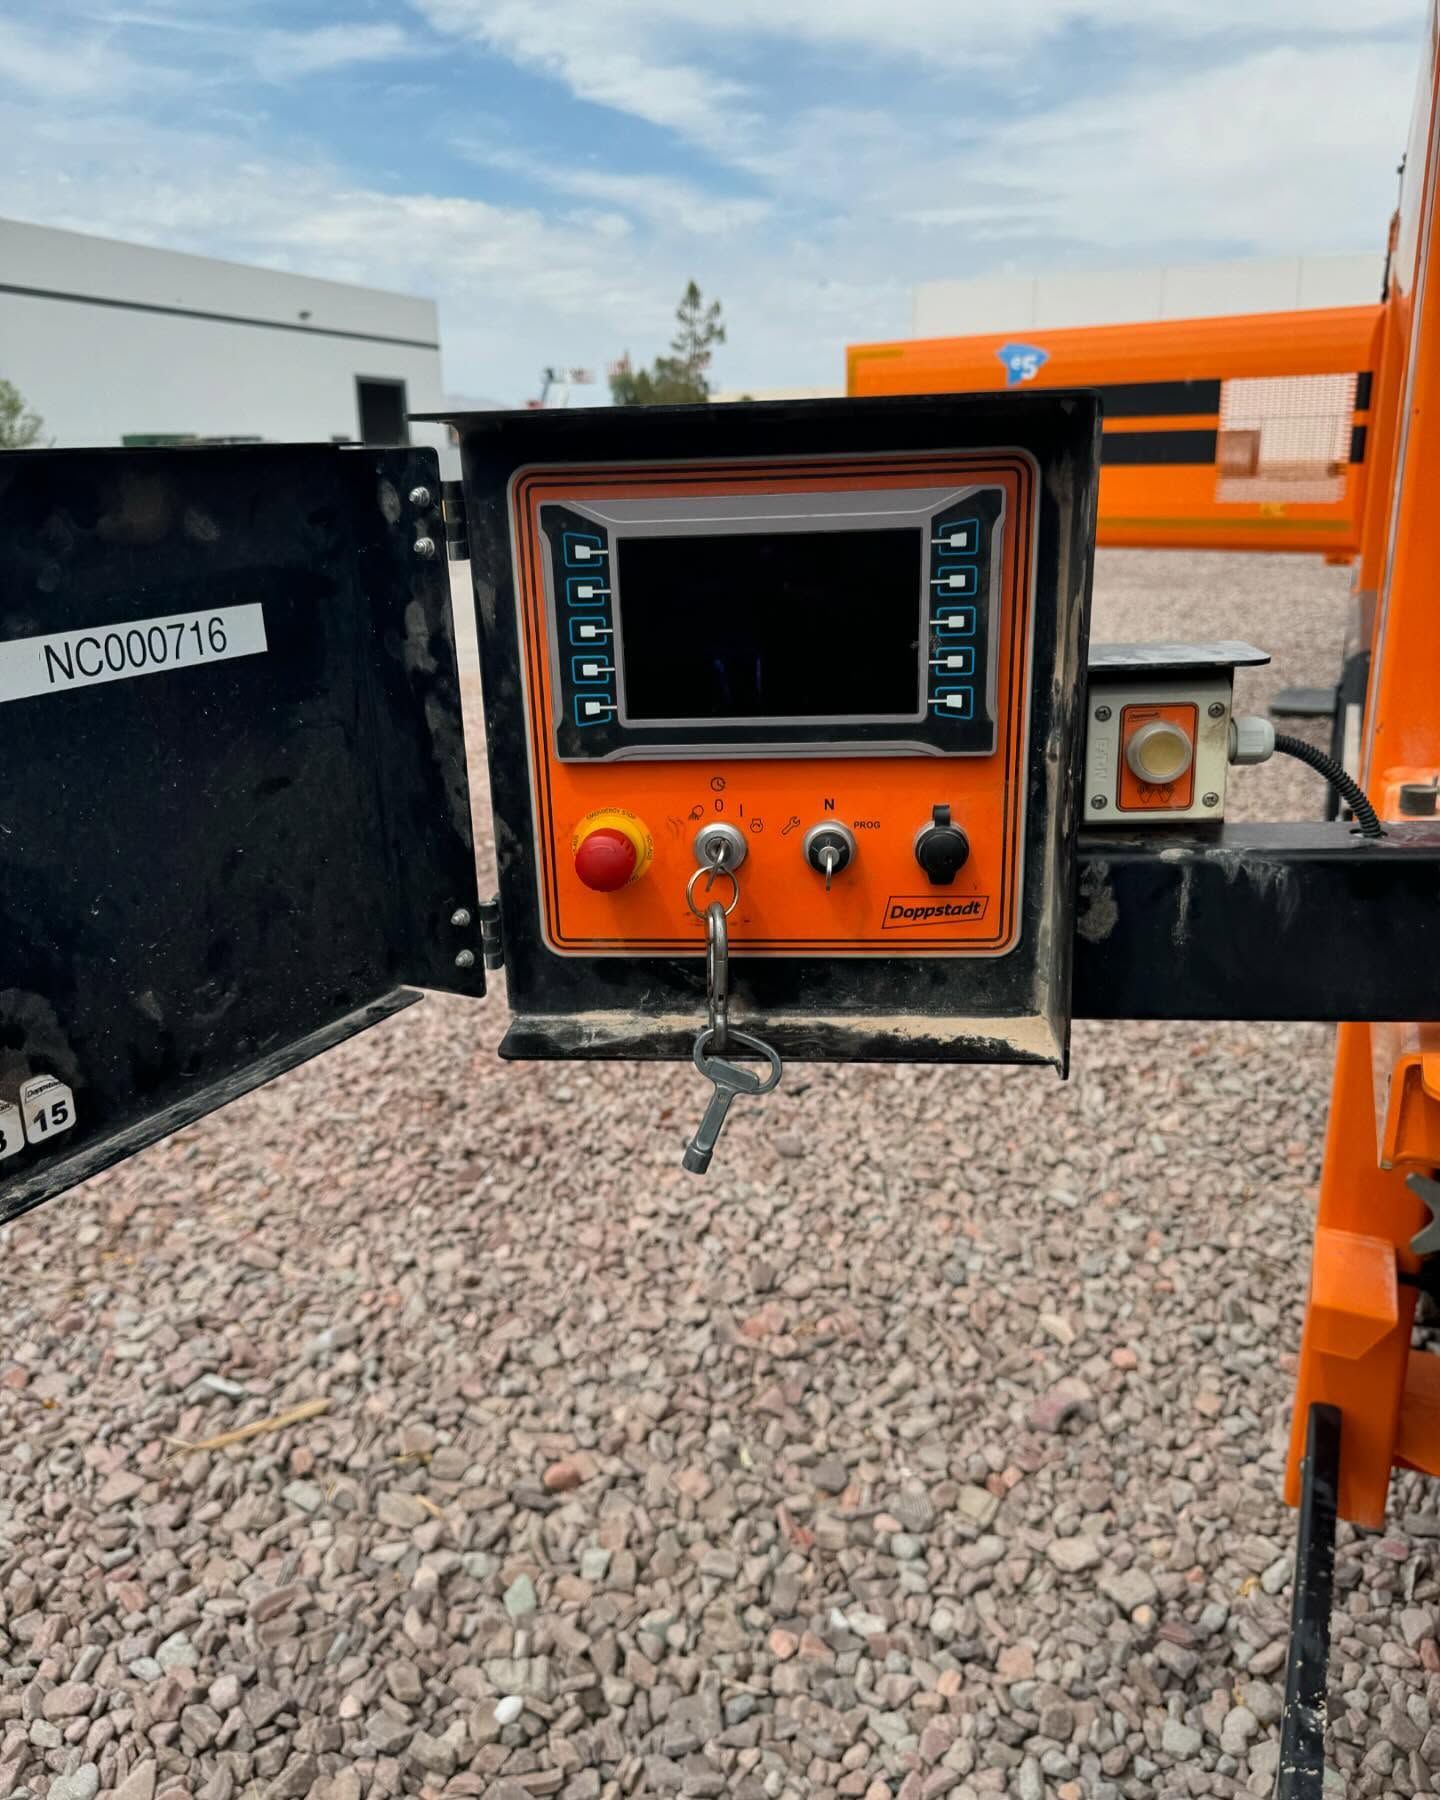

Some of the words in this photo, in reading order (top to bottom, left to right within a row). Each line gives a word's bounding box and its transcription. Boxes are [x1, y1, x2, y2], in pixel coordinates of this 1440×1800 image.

[43, 616, 227, 683] NC000716
[824, 798, 835, 811] N
[853, 820, 881, 830] PROG
[890, 901, 981, 921] Doppstadt
[33, 1099, 69, 1133] 15
